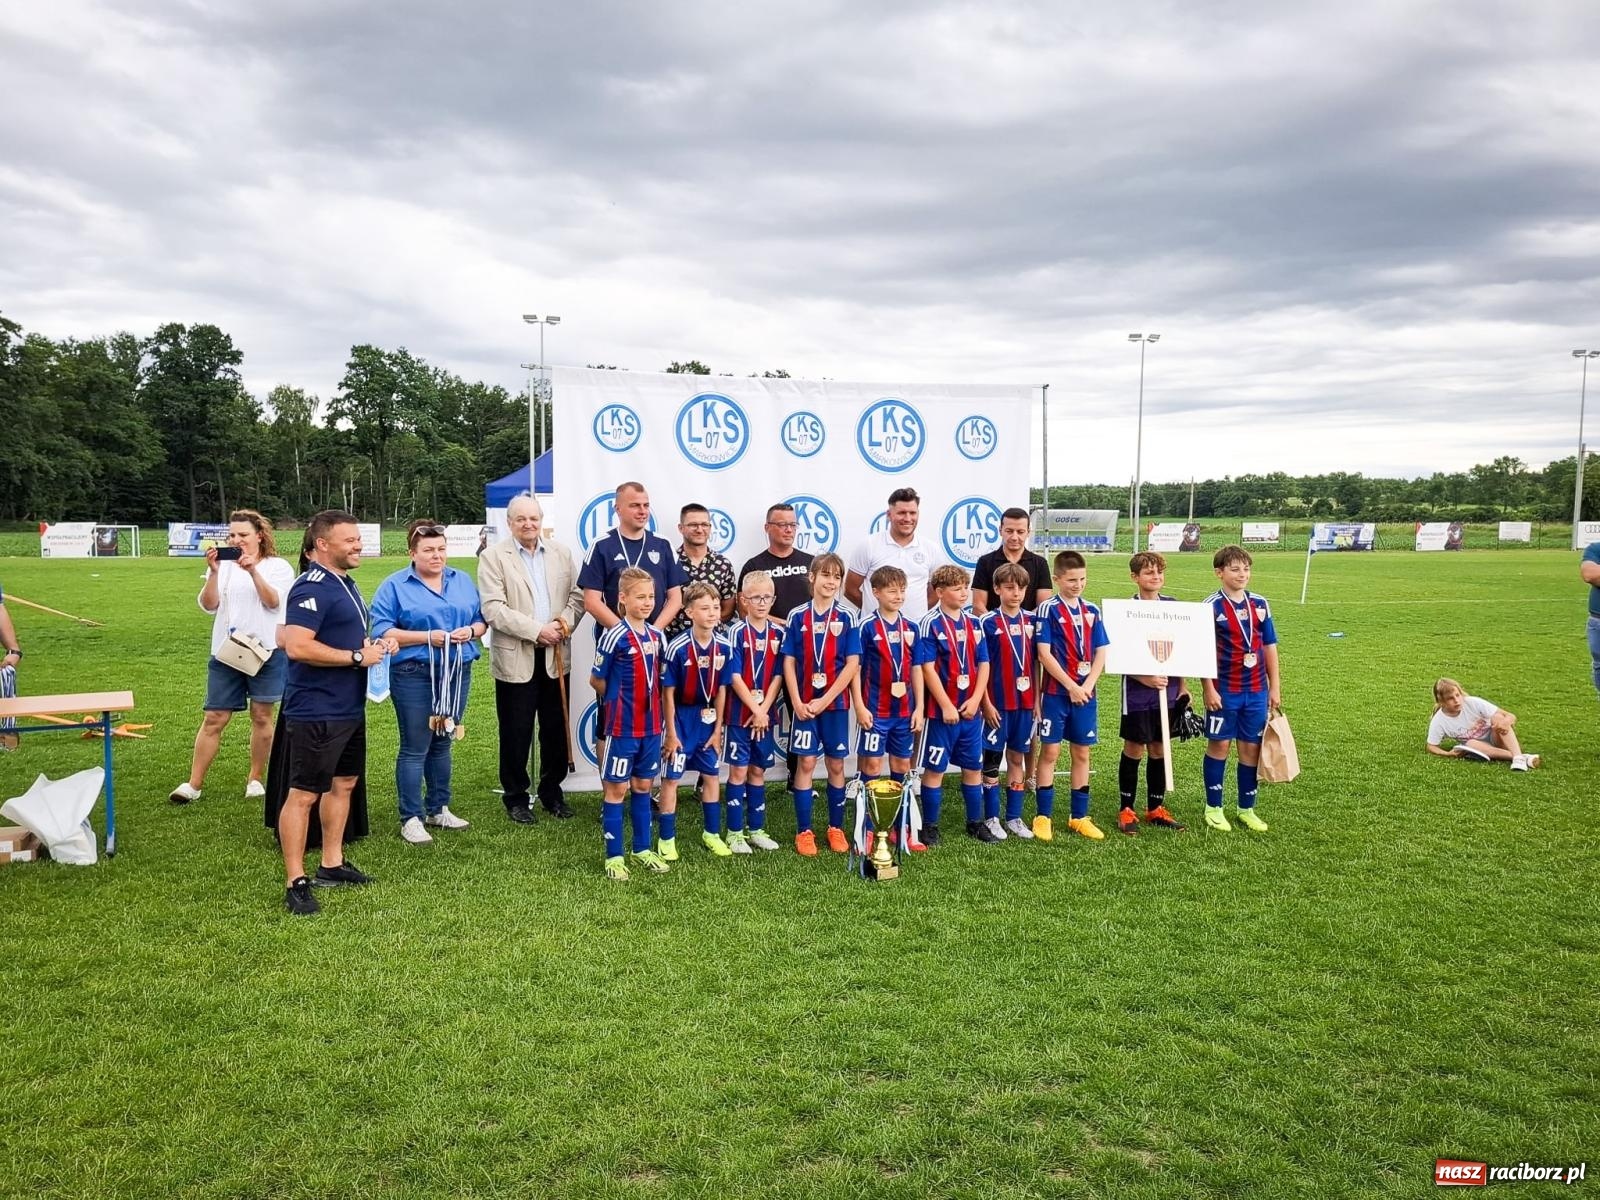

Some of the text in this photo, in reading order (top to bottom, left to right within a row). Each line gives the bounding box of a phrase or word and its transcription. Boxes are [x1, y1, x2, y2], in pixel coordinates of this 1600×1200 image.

[601, 409, 635, 436] LKS
[688, 401, 739, 443] LKS
[788, 416, 819, 442] LKS
[868, 407, 916, 447] LKS
[962, 420, 992, 444] LKS
[705, 432, 720, 449] 07
[885, 436, 898, 453] 07
[795, 503, 830, 543] KS
[953, 504, 999, 543] LKS
[797, 532, 810, 549] 07
[968, 533, 981, 549] 07
[766, 564, 808, 578] adidas
[1126, 610, 1191, 621] Polonia Bytom
[1209, 716, 1224, 734] 17
[794, 729, 811, 750] 20
[864, 732, 880, 752] 18
[673, 752, 686, 773] 19
[928, 745, 945, 766] 27
[611, 756, 628, 777] 10
